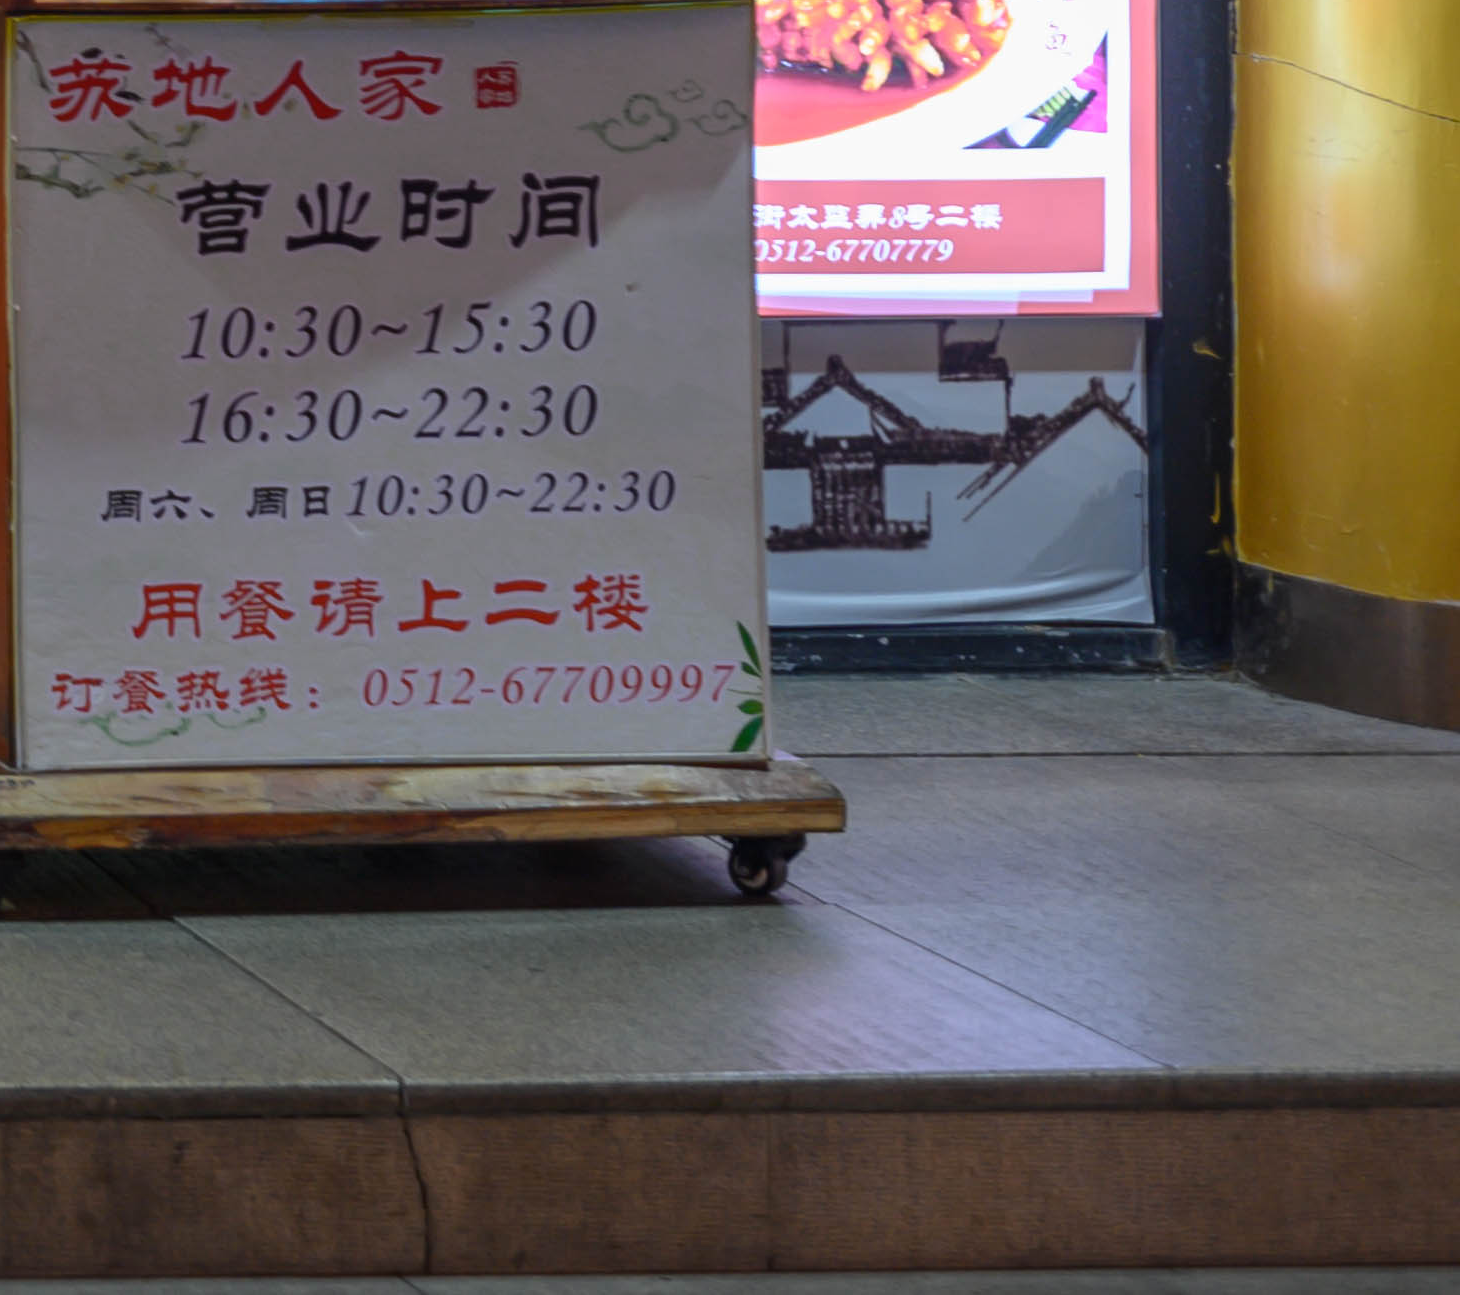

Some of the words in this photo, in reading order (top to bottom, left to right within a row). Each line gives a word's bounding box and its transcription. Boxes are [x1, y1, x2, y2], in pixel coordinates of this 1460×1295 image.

[50, 50, 444, 121] 苏地人家
[176, 173, 601, 257] 营业时间
[181, 299, 598, 361] 10:30~15:30
[181, 385, 598, 445] 16:30~22:30
[132, 575, 649, 641] 用餐请上二楼
[363, 664, 735, 708] 0512-67709997
